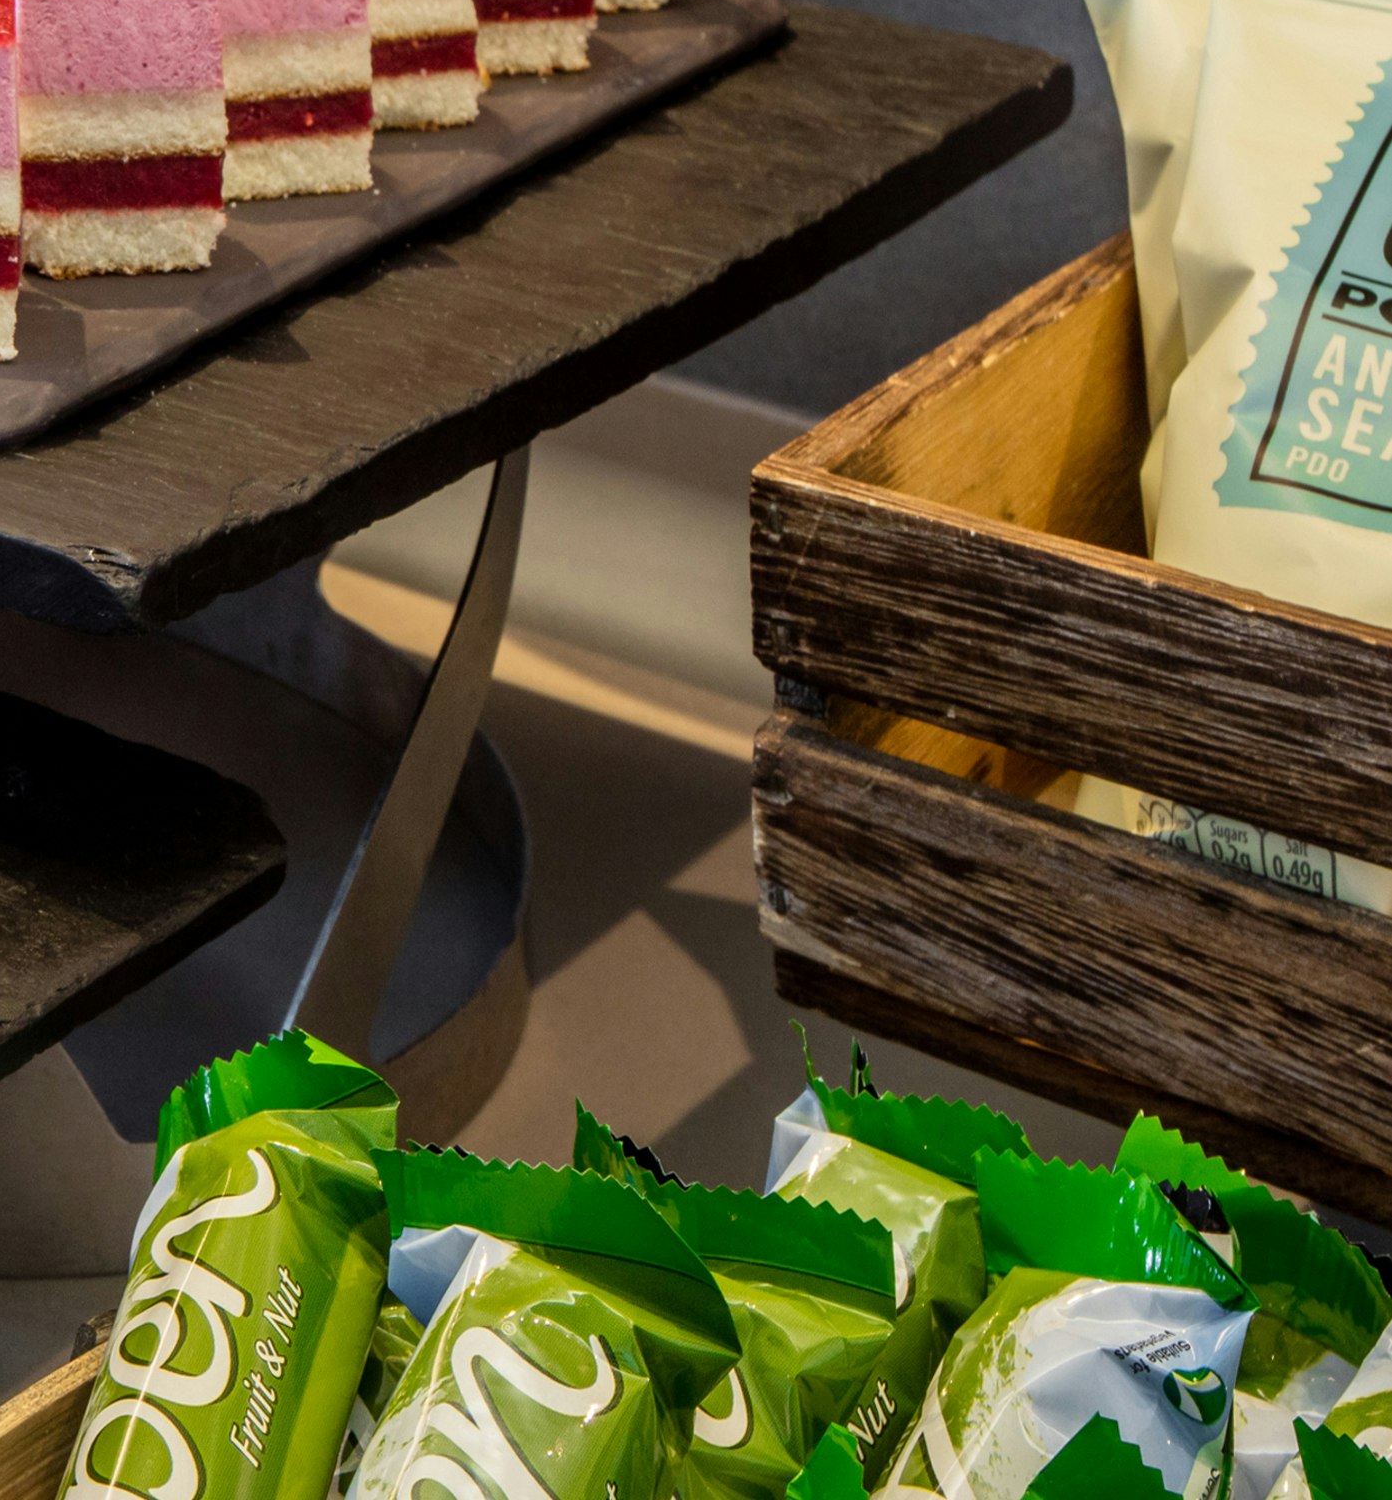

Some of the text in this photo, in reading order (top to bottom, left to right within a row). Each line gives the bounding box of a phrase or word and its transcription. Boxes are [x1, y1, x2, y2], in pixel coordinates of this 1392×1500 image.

[1284, 445, 1351, 484] PDO
[1210, 819, 1249, 844] Sugars
[1285, 837, 1309, 857] Salt
[1211, 840, 1252, 873] 0.2g
[1272, 854, 1324, 896] 0.49g
[229, 1264, 304, 1469] Fruit & Nut
[1129, 1339, 1192, 1376] Suitable for
[846, 1379, 897, 1462] Nut
